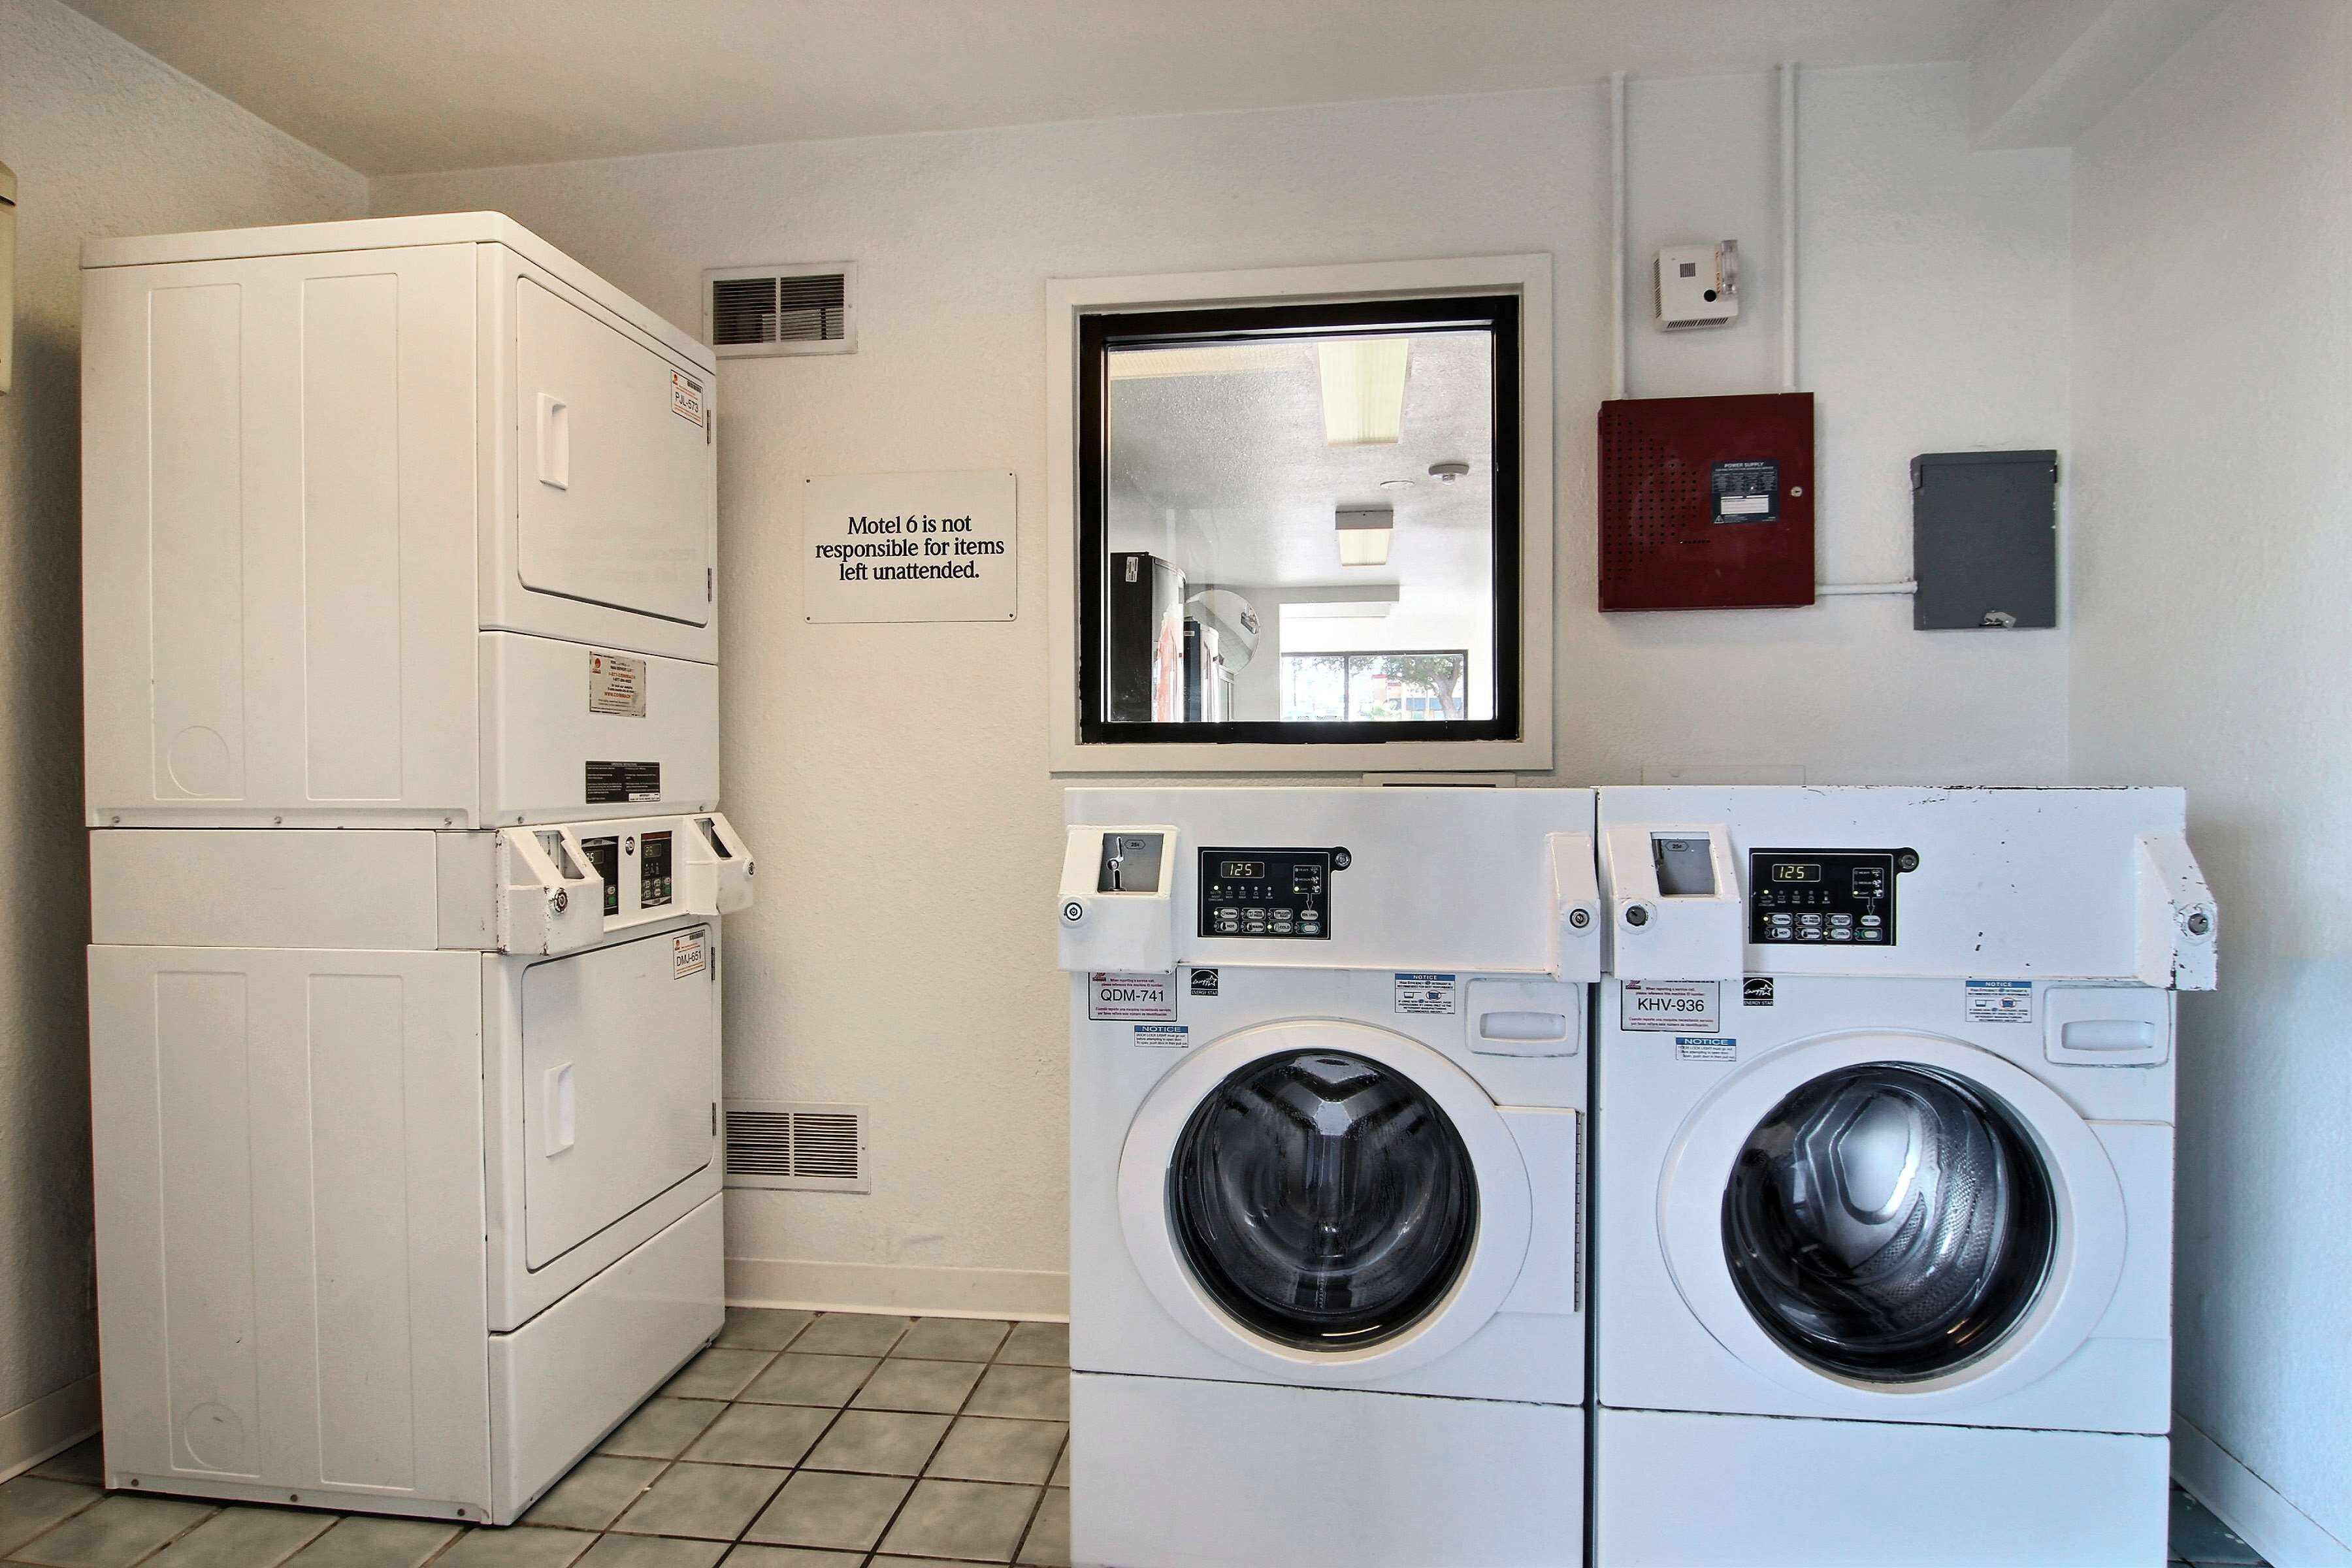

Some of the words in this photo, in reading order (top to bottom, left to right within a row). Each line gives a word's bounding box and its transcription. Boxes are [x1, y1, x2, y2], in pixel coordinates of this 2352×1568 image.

[675, 391, 698, 413] PJL-573
[847, 515, 902, 534] Motel
[906, 515, 918, 534] 6
[922, 515, 937, 533] is
[941, 515, 972, 532] not
[815, 538, 919, 562] responsible
[924, 537, 950, 555] for
[954, 537, 1005, 555] items
[840, 563, 868, 581] left
[873, 561, 980, 580] unattended.
[1230, 864, 1252, 876] 125
[1779, 866, 1805, 879] 125
[676, 950, 701, 966] DMJ-651
[1100, 988, 1164, 1002] QDM-741
[1638, 998, 1704, 1012] KHV-936
